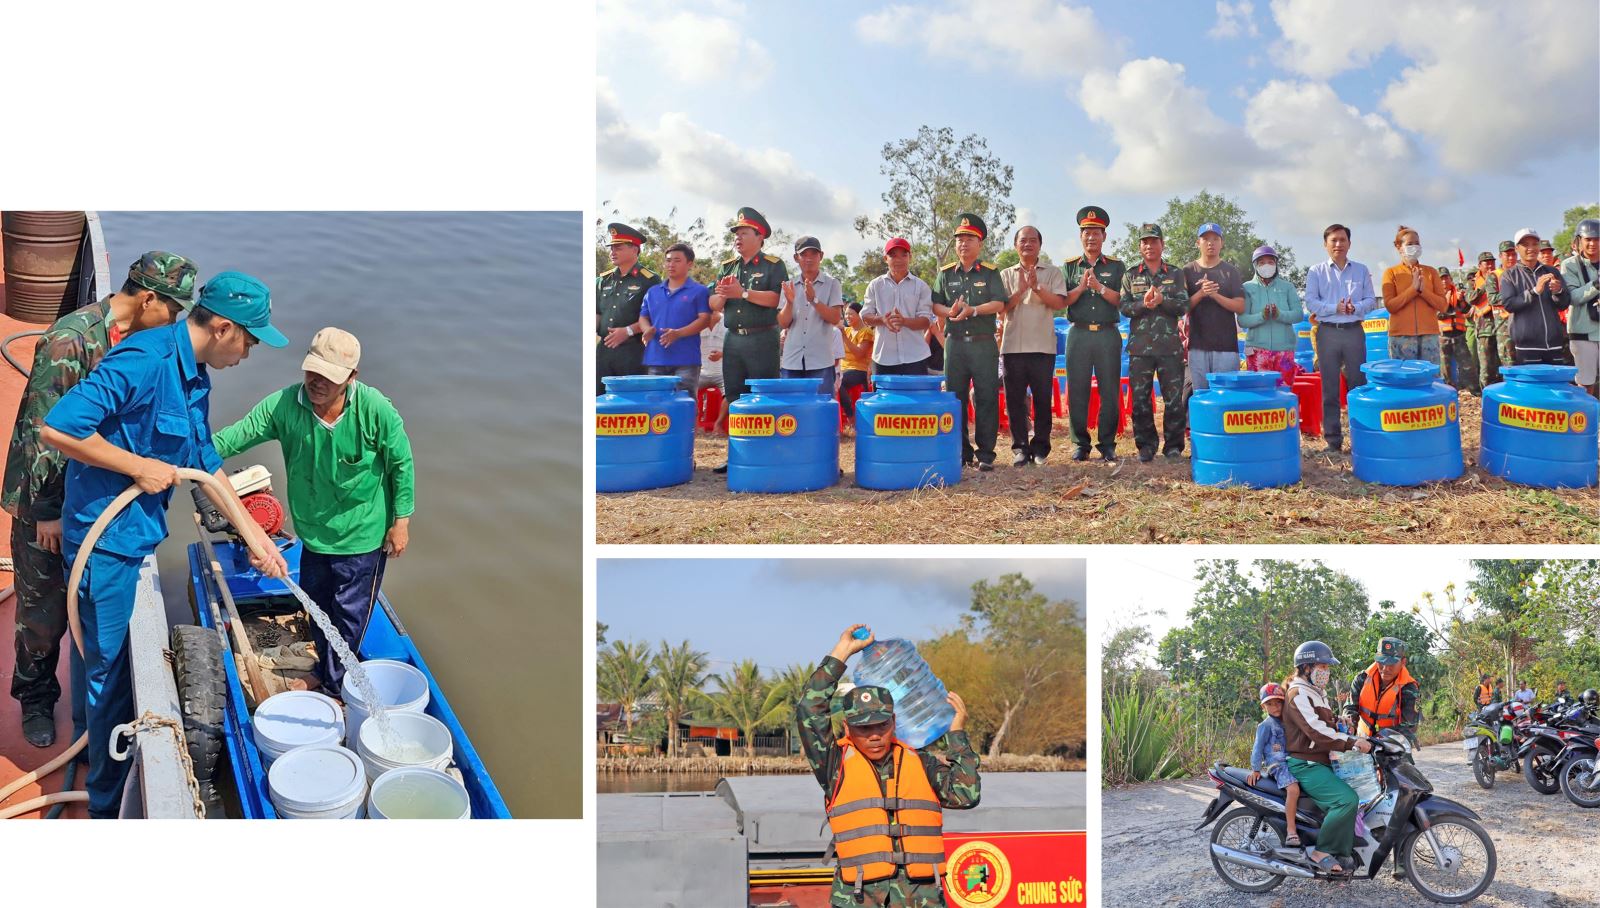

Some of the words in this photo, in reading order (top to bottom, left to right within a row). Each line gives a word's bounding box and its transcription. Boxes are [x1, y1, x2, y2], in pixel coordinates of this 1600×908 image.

[1363, 319, 1386, 329] ENTAY
[1226, 410, 1286, 426] MIENTAY
[1383, 406, 1444, 424] MIENTAY
[1501, 405, 1566, 425] MIENTAY
[1574, 415, 1584, 425] 10
[596, 416, 647, 428] IENTAY
[656, 417, 668, 427] 10
[781, 418, 794, 428] 10
[876, 416, 937, 429] MIENTAY
[943, 416, 952, 426] 10
[1525, 422, 1564, 431] PLASTIC
[1017, 881, 1057, 905] CHUNG
[1059, 875, 1083, 904] SỨC
